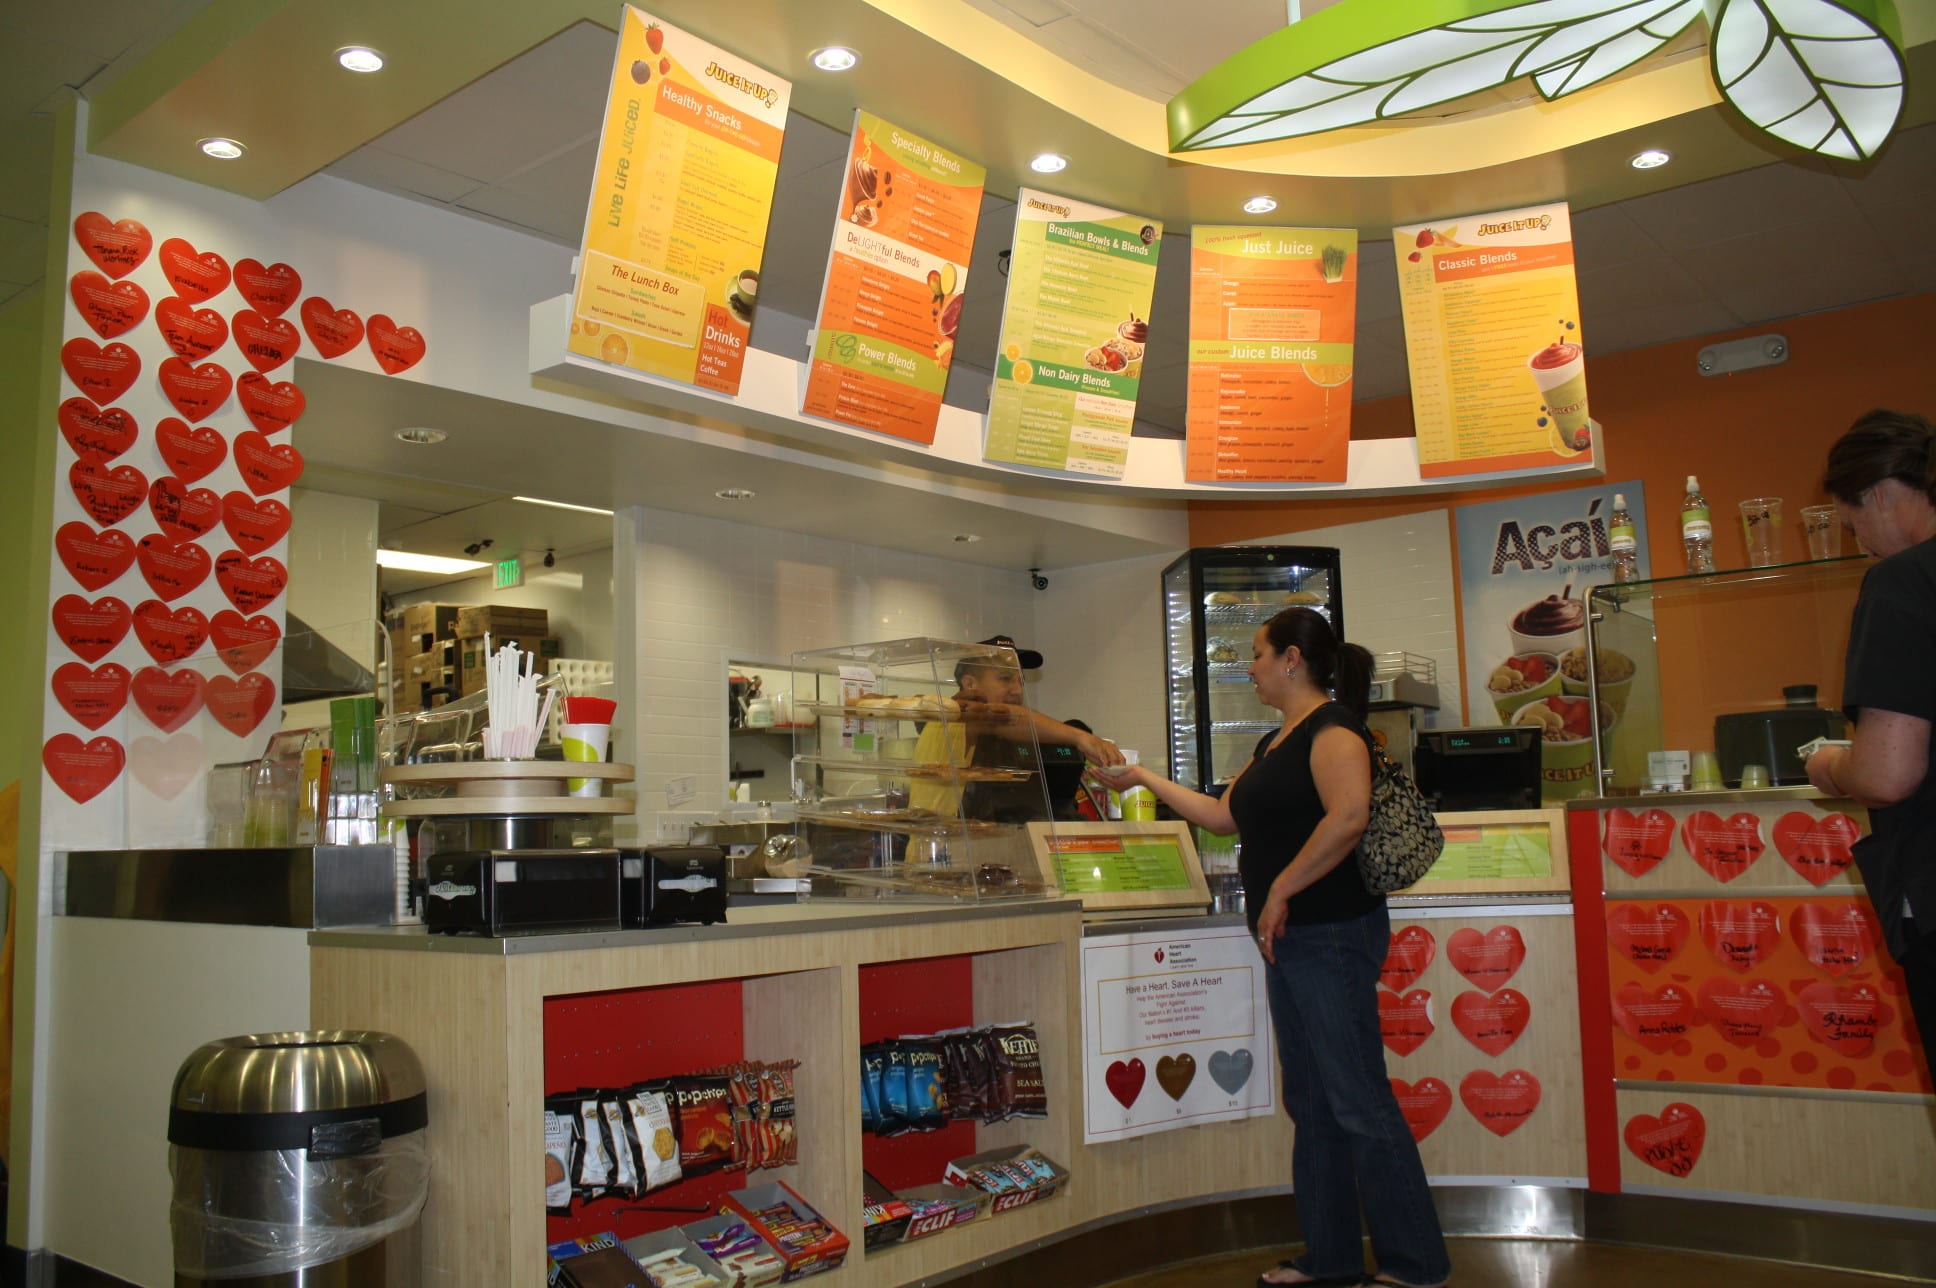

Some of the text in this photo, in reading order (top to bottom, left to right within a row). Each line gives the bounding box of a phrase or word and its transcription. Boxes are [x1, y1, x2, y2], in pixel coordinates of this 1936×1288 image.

[705, 62, 740, 88] JUICE
[740, 77, 753, 94] IT
[662, 84, 742, 130] Healthy Snacks
[890, 132, 935, 160] Specialty
[933, 150, 961, 174] Blends
[1478, 222, 1512, 236] JUICE
[1512, 220, 1524, 231] IT
[1048, 223, 1149, 256] Brazilian Bowls & Blends
[1242, 239, 1313, 255] Just Juice
[894, 250, 920, 269] Blends
[1438, 251, 1518, 271] Classic Blends
[611, 264, 680, 296] The Lunch Box
[708, 308, 729, 327] Hot
[705, 326, 741, 348] Drinks
[702, 354, 727, 368] Hot Teas
[858, 343, 885, 361] Power
[887, 352, 917, 372] Blends
[1229, 345, 1317, 360] Juice Blends
[700, 365, 719, 376] Coffee
[1038, 365, 1112, 388] Non Dairy Blends
[1491, 498, 1610, 575] Açaí
[497, 559, 517, 586] EXIT
[1126, 985, 1140, 994] Have
[1172, 980, 1190, 989] Save
[1192, 978, 1198, 986] A
[1200, 976, 1223, 986] Heart
[1152, 1032, 1168, 1040] buying
[1017, 1079, 1029, 1087] SEA
[678, 1088, 727, 1106] popchips
[1003, 1190, 1035, 1208] CLIF
[920, 1210, 956, 1233] CLIF
[581, 1238, 615, 1253] KIND
